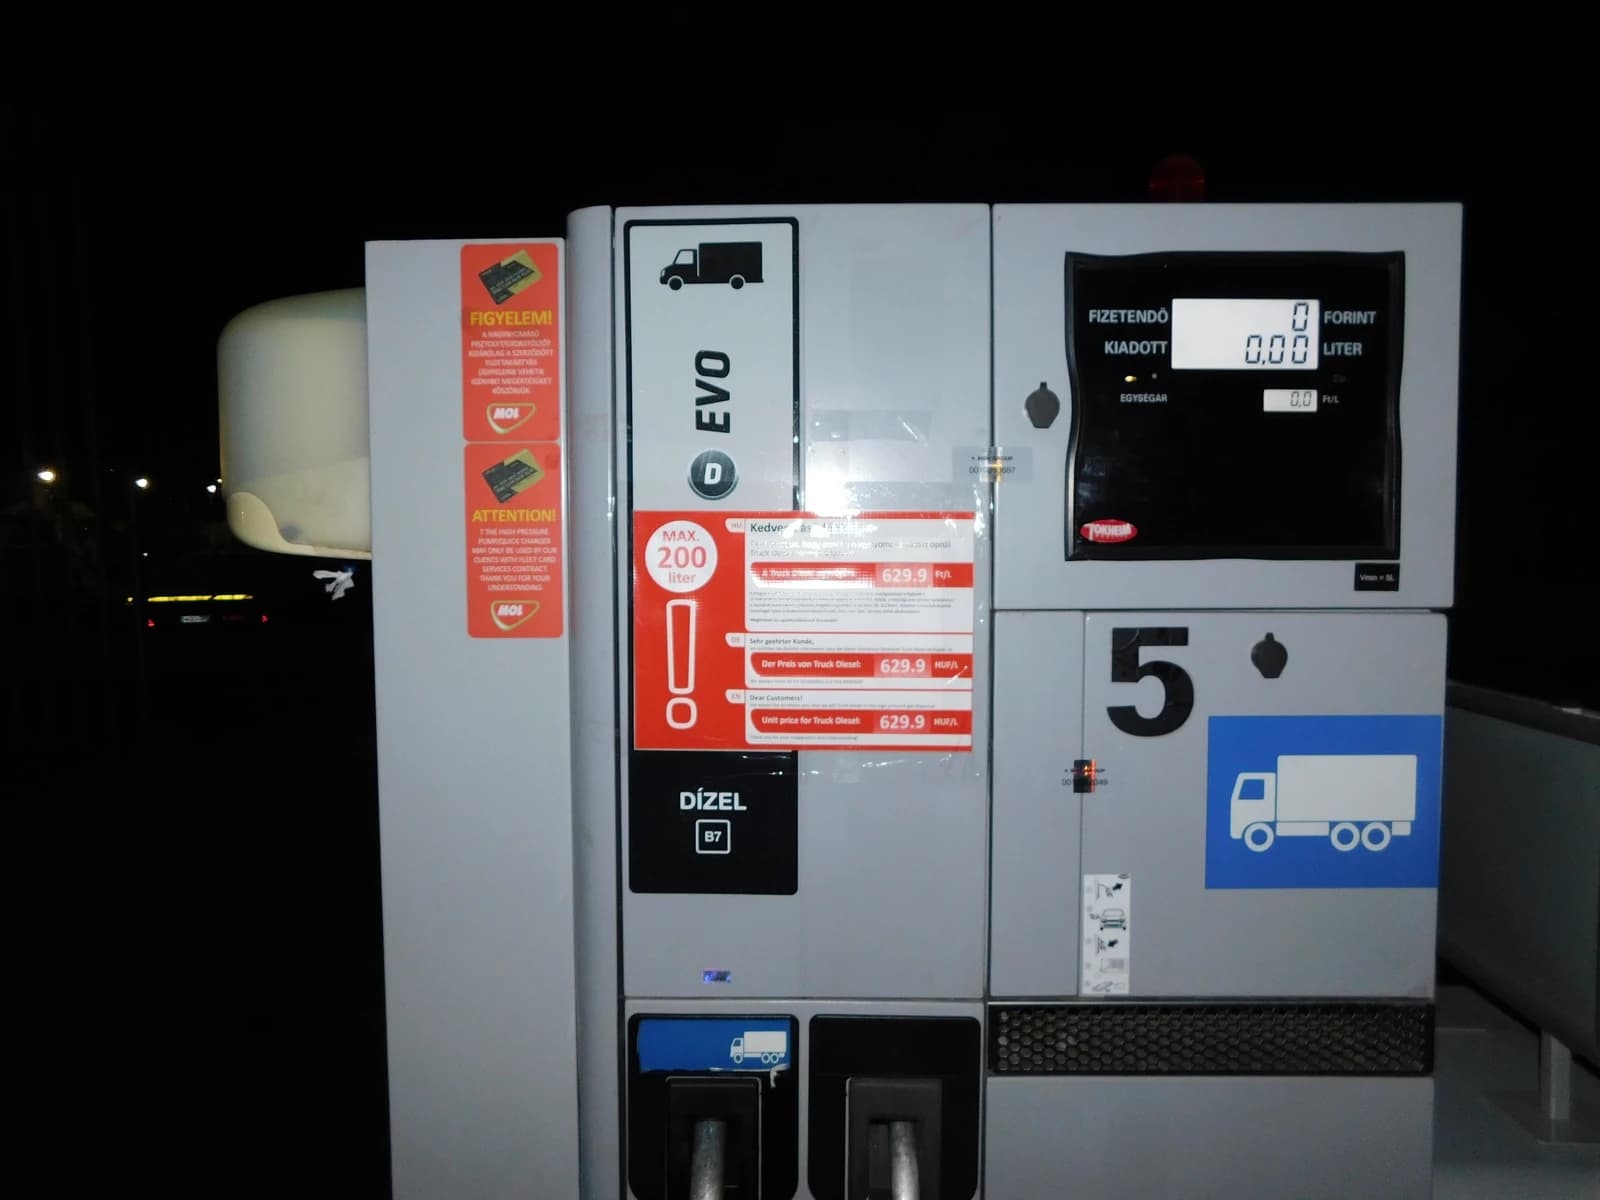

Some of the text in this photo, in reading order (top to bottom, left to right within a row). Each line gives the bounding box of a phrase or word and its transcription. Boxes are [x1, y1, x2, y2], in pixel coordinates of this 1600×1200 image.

[470, 310, 553, 326] FIGYELEM!
[1292, 302, 1309, 331] 0
[1323, 310, 1377, 325] FORINT
[1104, 340, 1168, 355] KIADOTT
[1323, 342, 1362, 356] LITER
[695, 350, 731, 434] EVO
[493, 407, 520, 420] MOL
[704, 462, 722, 485] D
[472, 508, 557, 523] ATTENTION!
[662, 530, 700, 542] MAX.
[1082, 522, 1132, 541] TOKHEIM
[657, 546, 707, 569] 200
[668, 571, 697, 585] liter
[881, 567, 928, 583] 629.9
[497, 604, 523, 617] MOL
[761, 659, 862, 669] Der Preis von Truck Diesel:
[880, 658, 959, 674] 629.9 HUF/L
[1106, 626, 1194, 737] 5
[761, 716, 861, 726] Unit price for Truck Diesel:
[879, 714, 926, 729] 629.9
[679, 786, 748, 811] DÍZEL
[704, 830, 722, 843] B7
